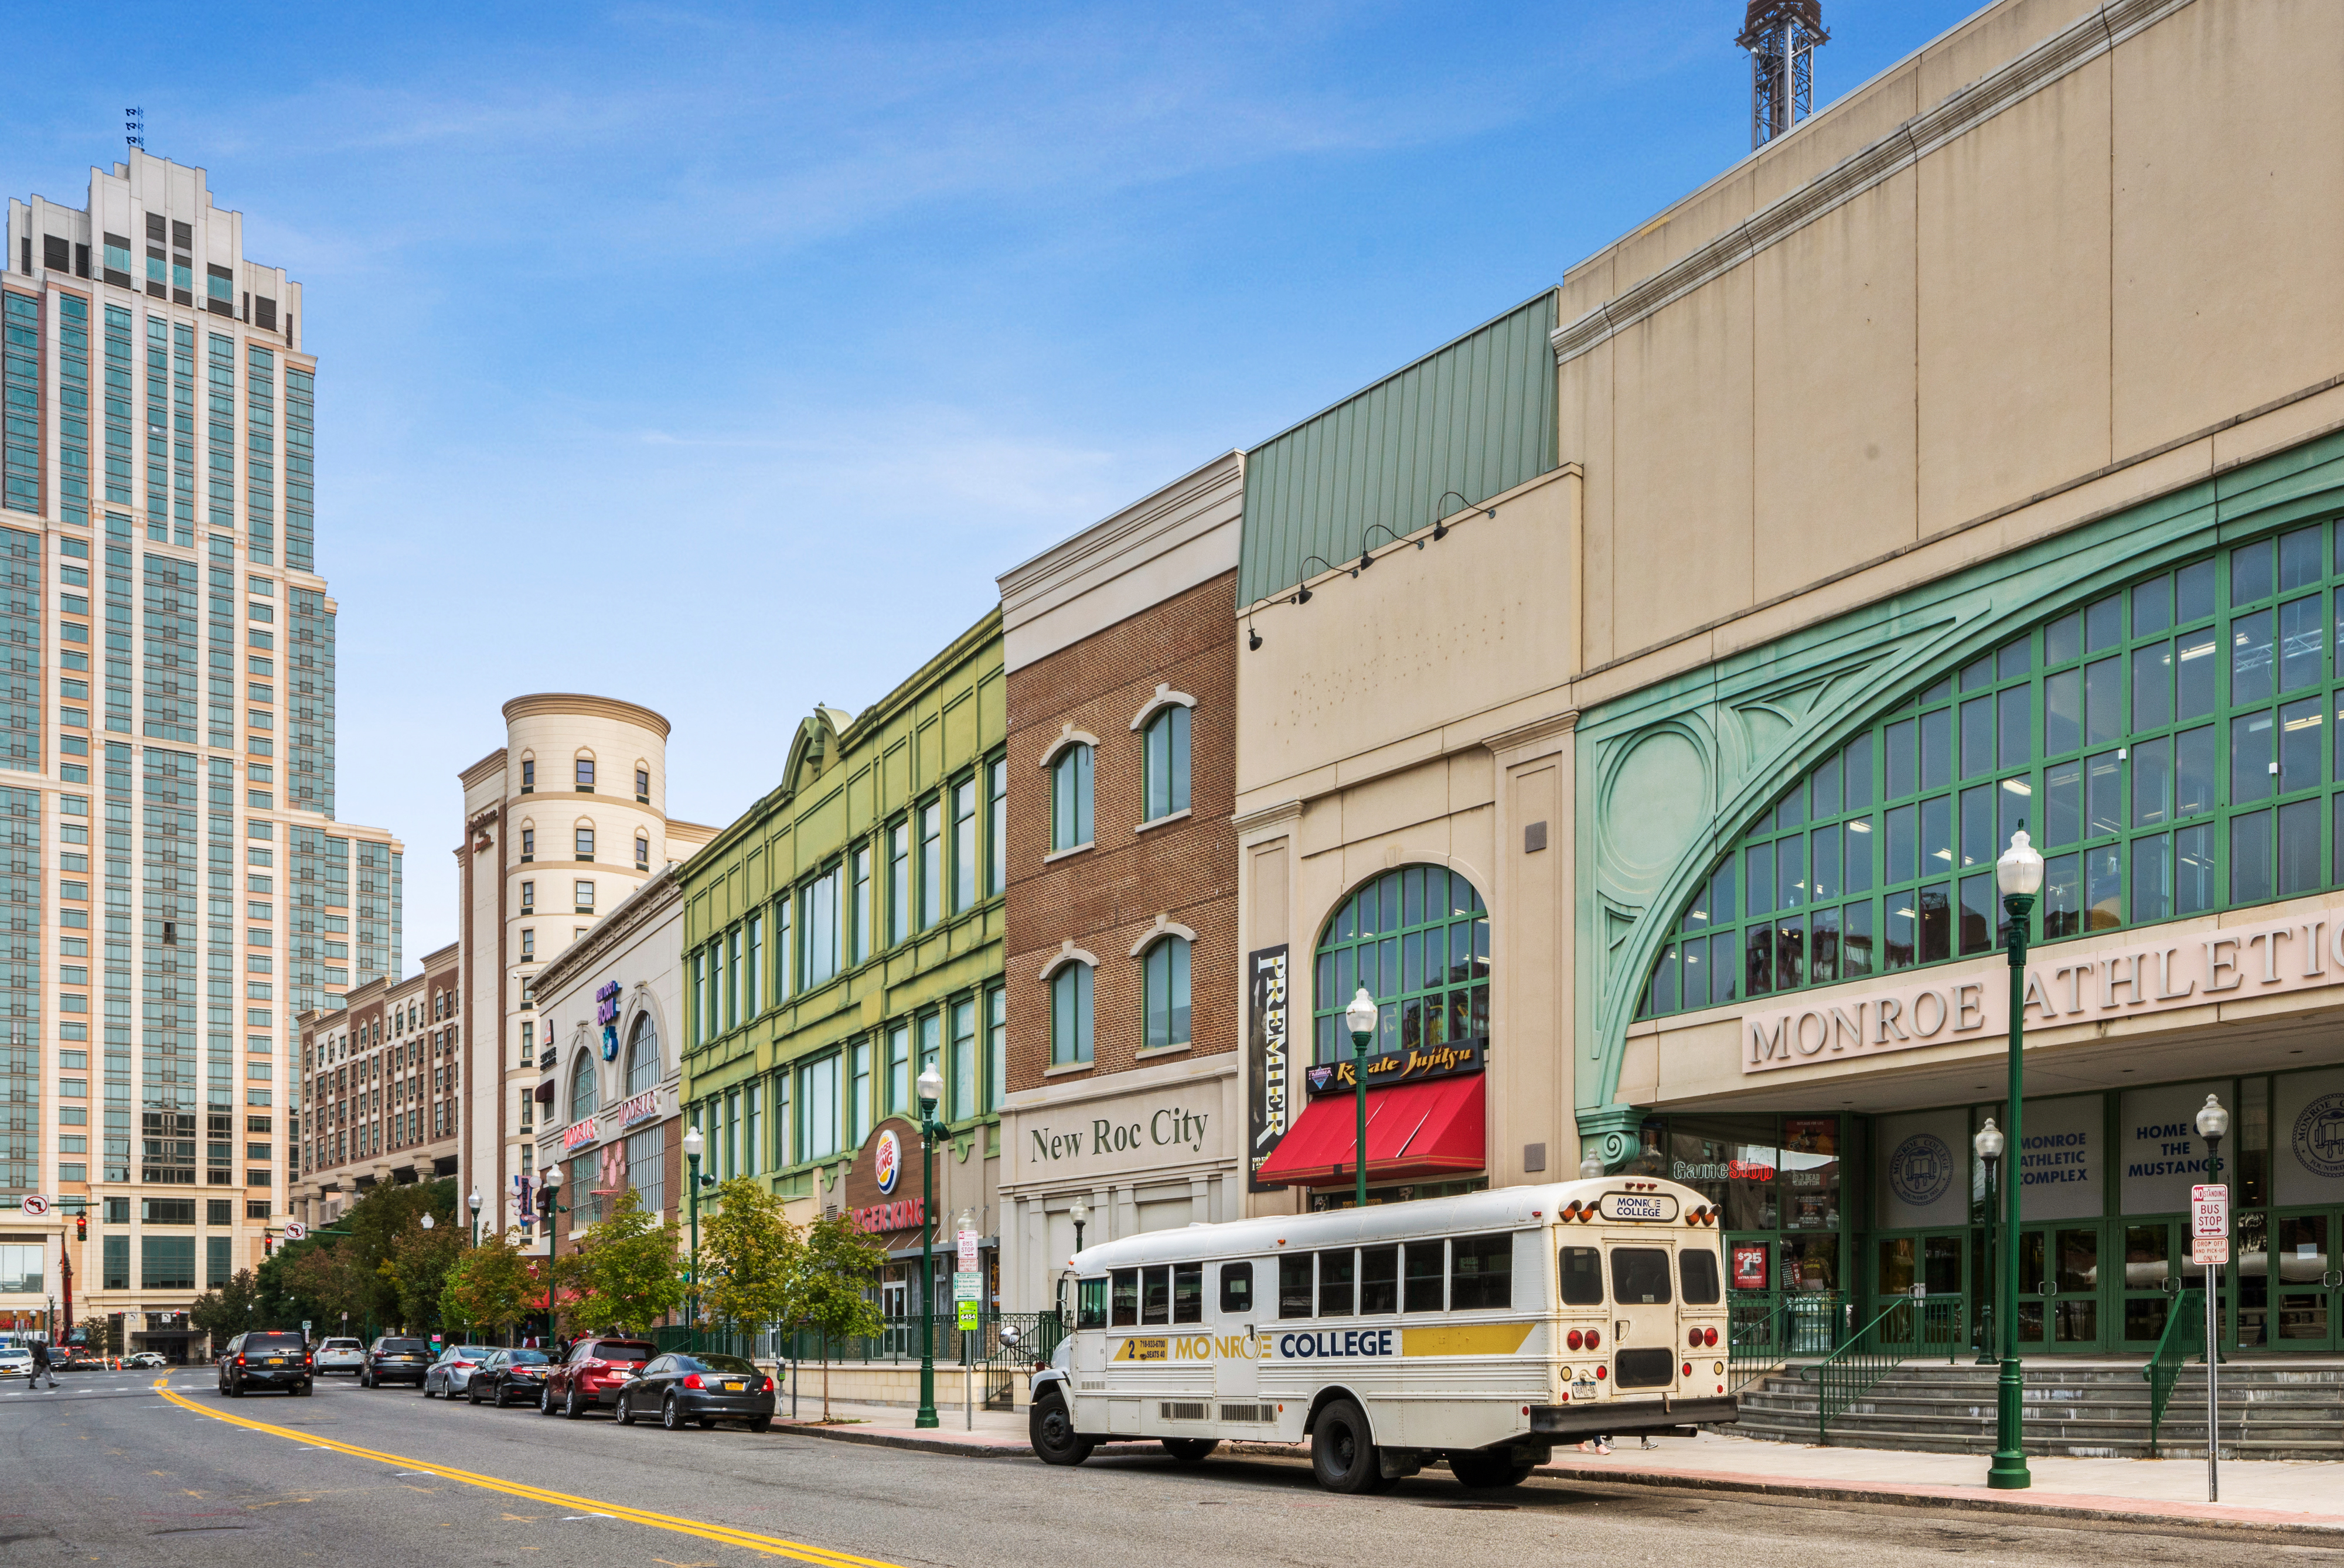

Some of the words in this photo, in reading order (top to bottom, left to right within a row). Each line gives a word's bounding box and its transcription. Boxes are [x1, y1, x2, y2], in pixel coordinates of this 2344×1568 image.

[1748, 982, 1985, 1063] MONROE
[1256, 951, 1286, 1149] PREMIER
[1337, 1056, 1402, 1086] Kate
[1399, 1045, 1474, 1079] Jujitsu
[2298, 1100, 2331, 1141] MONROE
[1031, 1127, 1083, 1163] New
[1092, 1119, 1142, 1155] Roc
[1150, 1107, 1208, 1152] City
[2137, 1123, 2187, 1140] HOME
[2021, 1133, 2086, 1150] MONROE
[2161, 1141, 2190, 1156] THE
[876, 1141, 892, 1164] BURGER
[1893, 1140, 1919, 1174] MONROE
[1924, 1139, 1949, 1171] COLLEGE
[2021, 1150, 2085, 1167] ATHLETIC
[876, 1151, 892, 1180] KING
[1674, 1160, 1773, 1181] GameStop
[2021, 1168, 2088, 1185] OMPLEX
[1617, 1198, 1661, 1208] MONROE
[1902, 1189, 1928, 1200] FOUNDED
[2193, 1189, 2203, 1199] NO
[838, 1204, 888, 1235] RGER
[890, 1197, 925, 1229] KING
[1617, 1207, 1660, 1217] COLLEGE
[2201, 1204, 2219, 1214] BUS
[2199, 1216, 2222, 1226] STOP
[1737, 1252, 1762, 1264] $25
[1129, 1340, 1135, 1359] 2
[1175, 1334, 1272, 1360] MONROE
[1280, 1330, 1392, 1358] COLLEGE
